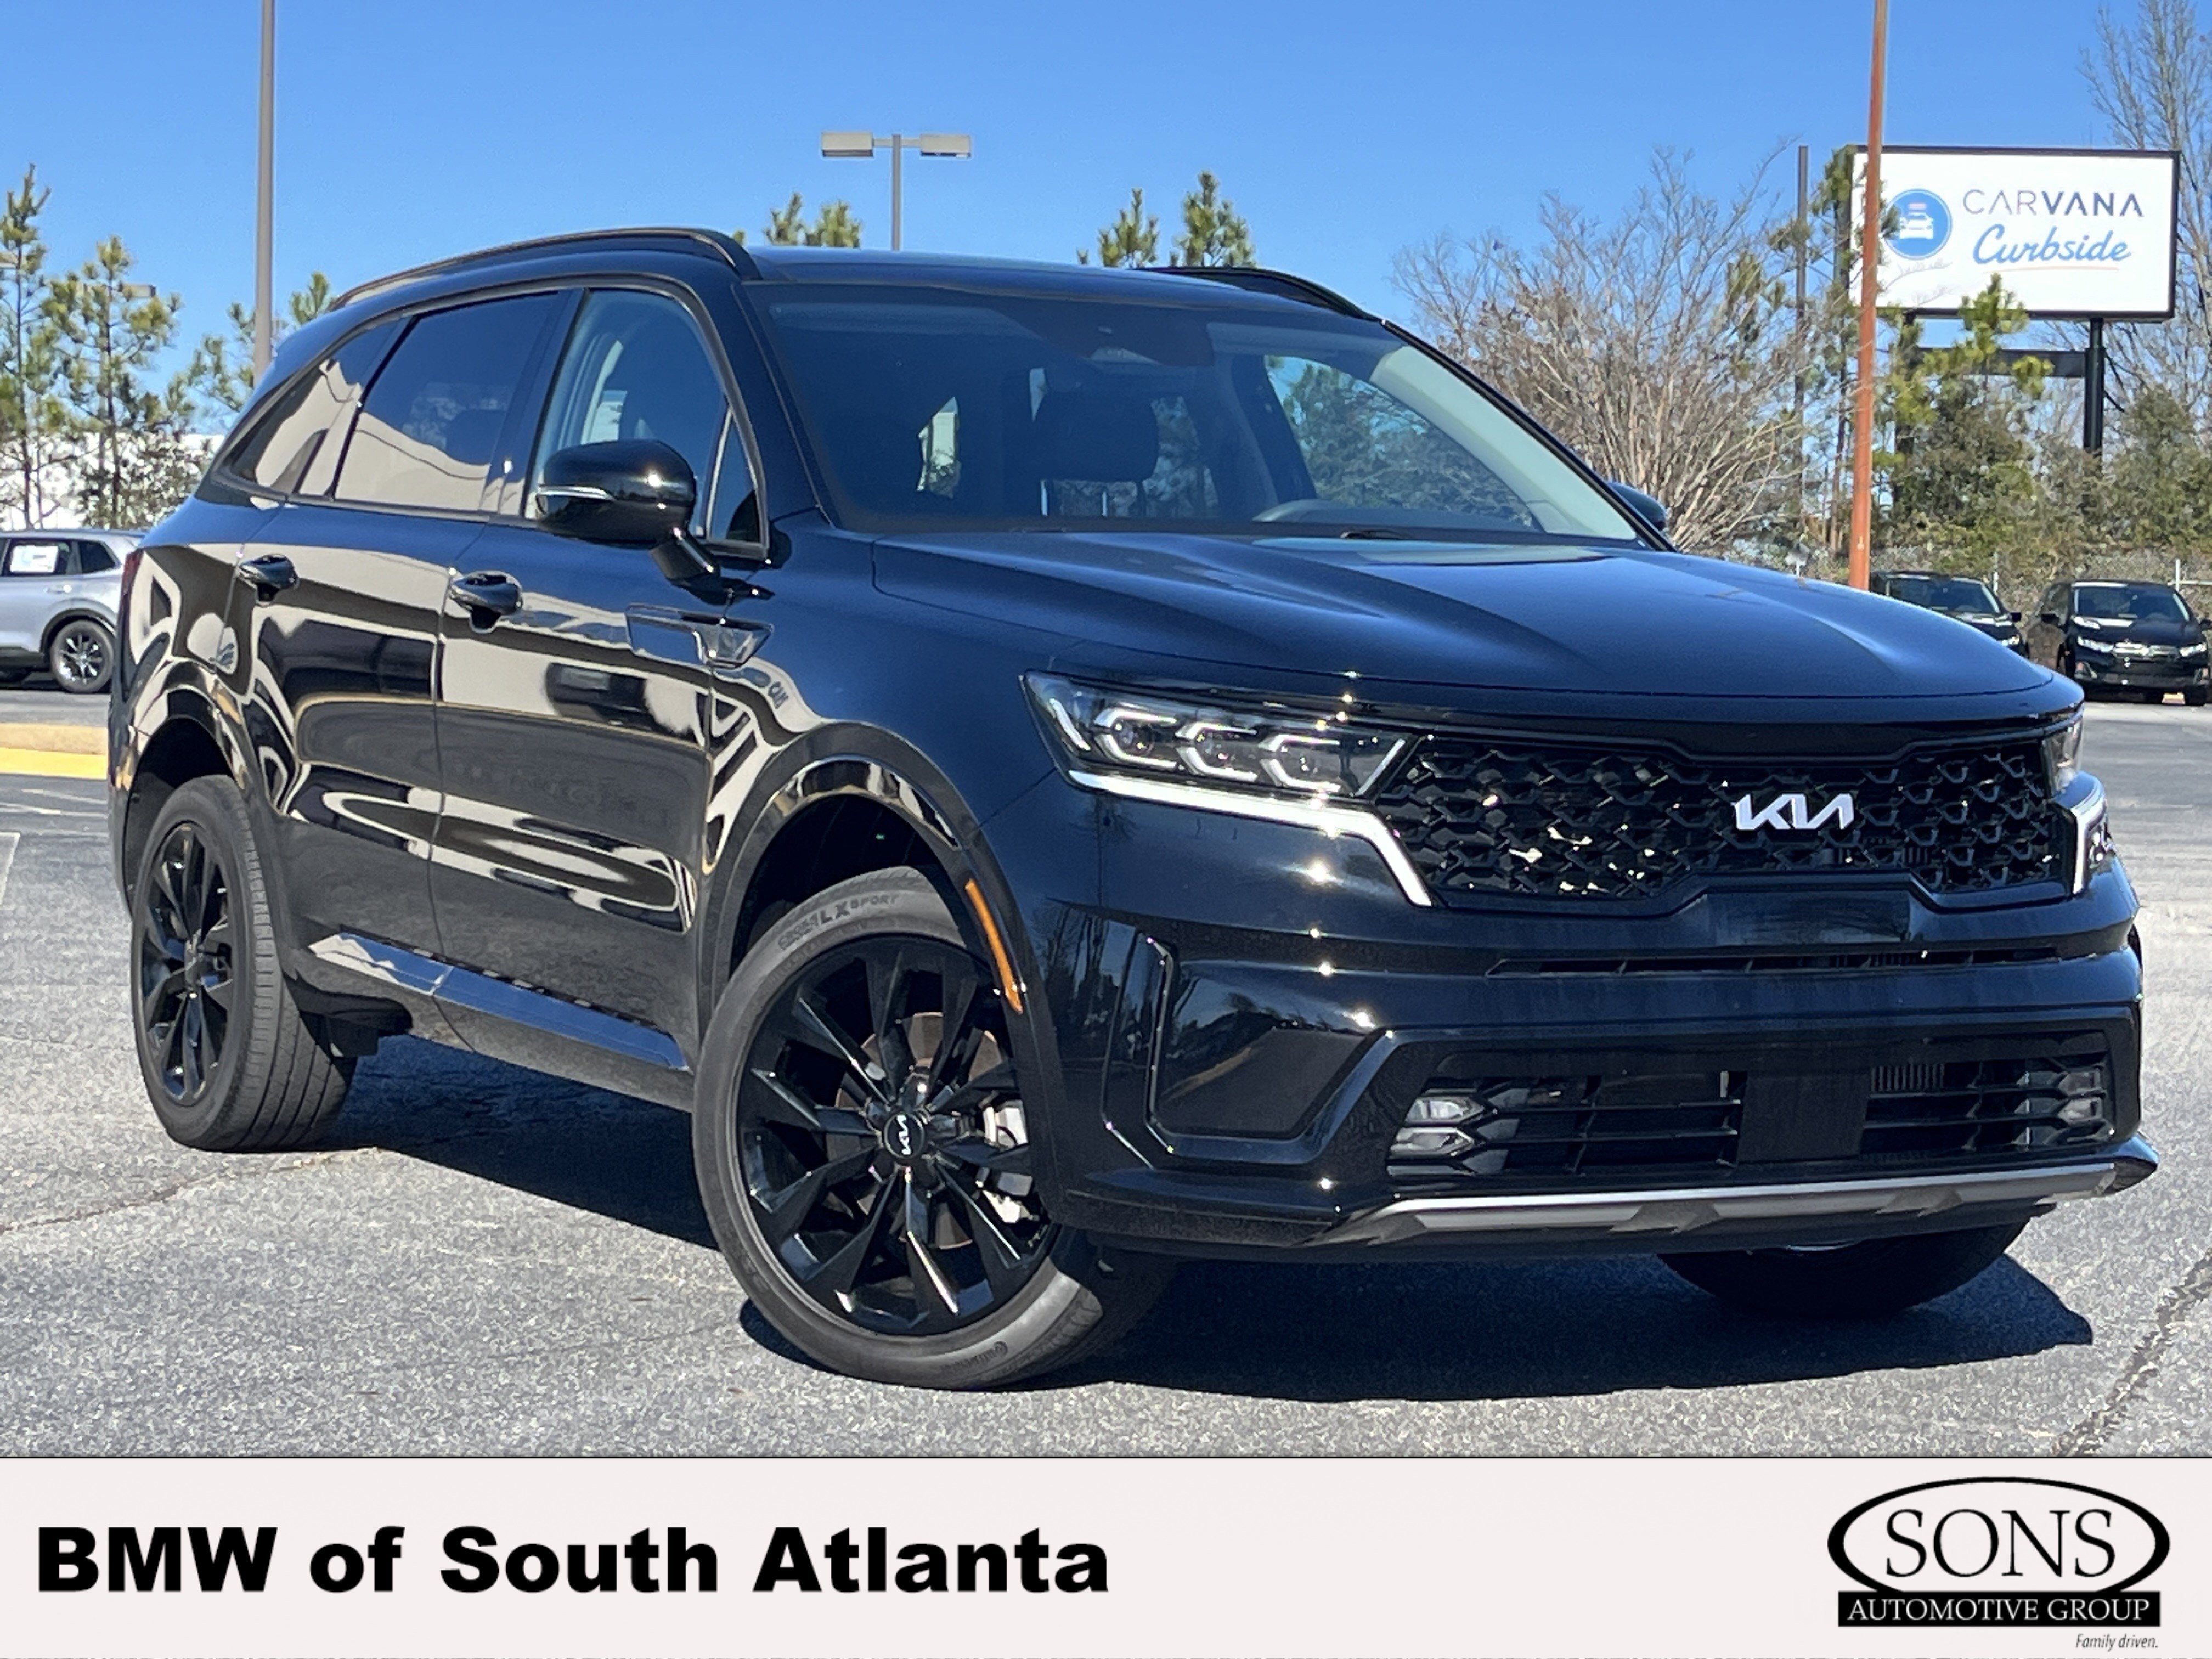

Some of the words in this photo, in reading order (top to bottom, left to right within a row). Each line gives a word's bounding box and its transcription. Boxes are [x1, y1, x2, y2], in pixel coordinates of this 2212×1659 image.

[1963, 190, 2143, 217] CARVANA
[1973, 224, 2131, 264] Curbside
[1734, 793, 1854, 830] KIA
[820, 900, 851, 924] LX
